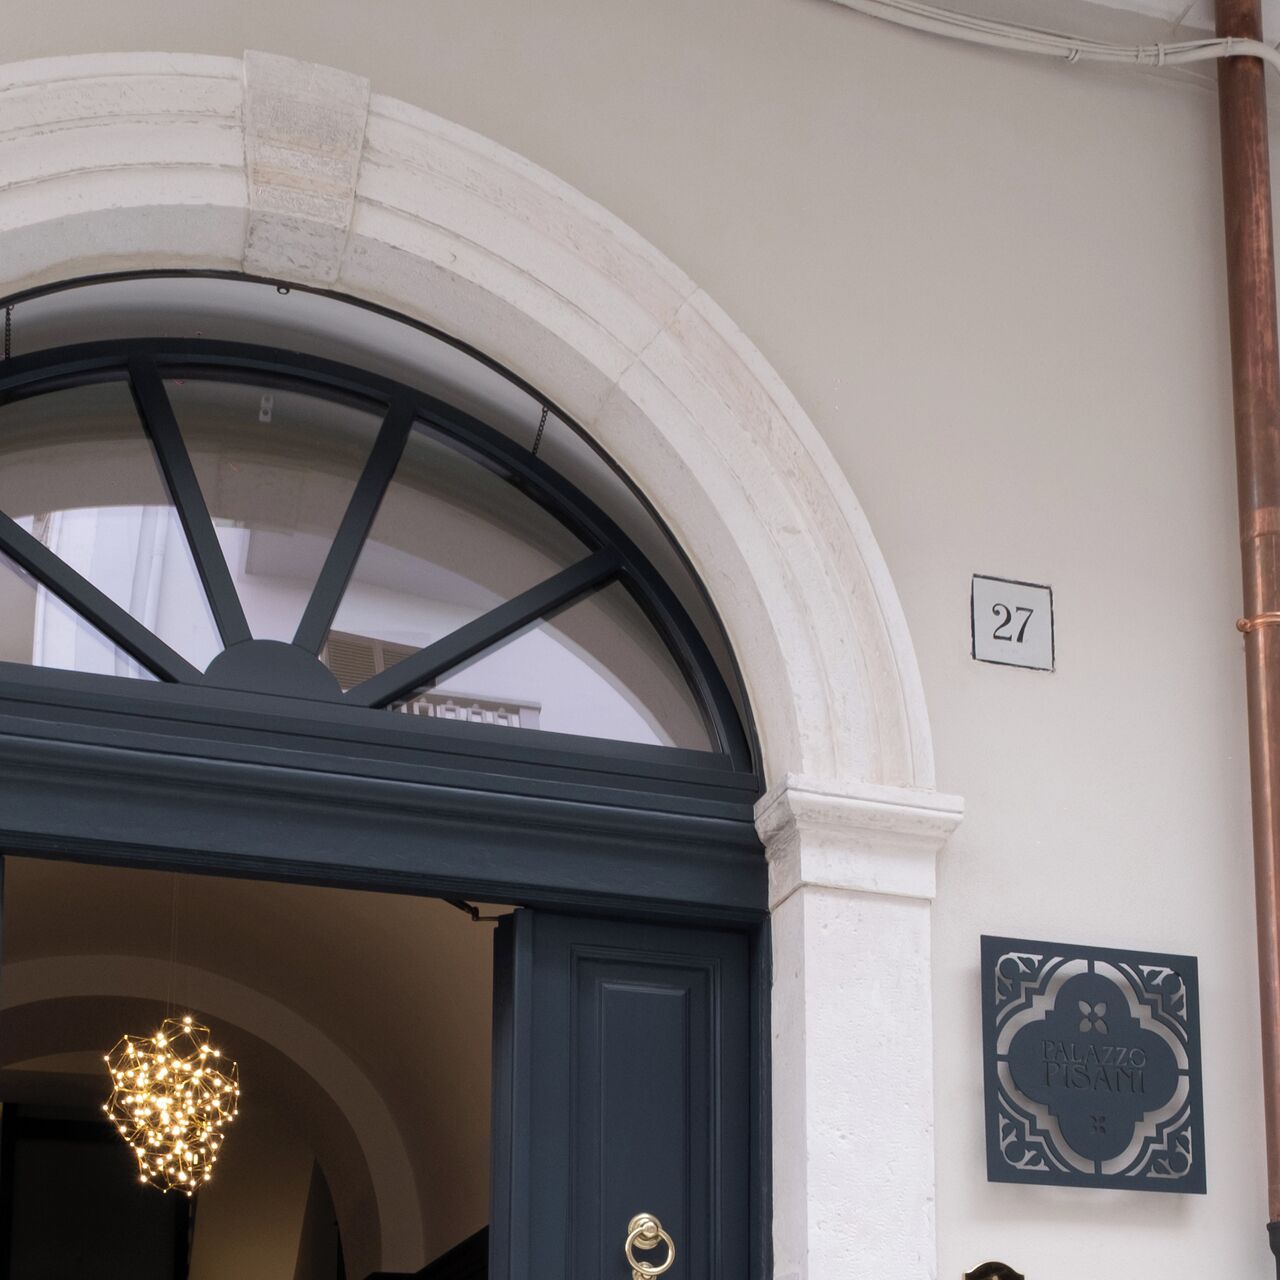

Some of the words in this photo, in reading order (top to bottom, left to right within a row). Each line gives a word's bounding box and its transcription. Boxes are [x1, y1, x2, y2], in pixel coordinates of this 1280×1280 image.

[992, 602, 1034, 644] 27
[1041, 1039, 1147, 1069] PALAZZO
[1042, 1060, 1147, 1094] PISANI
